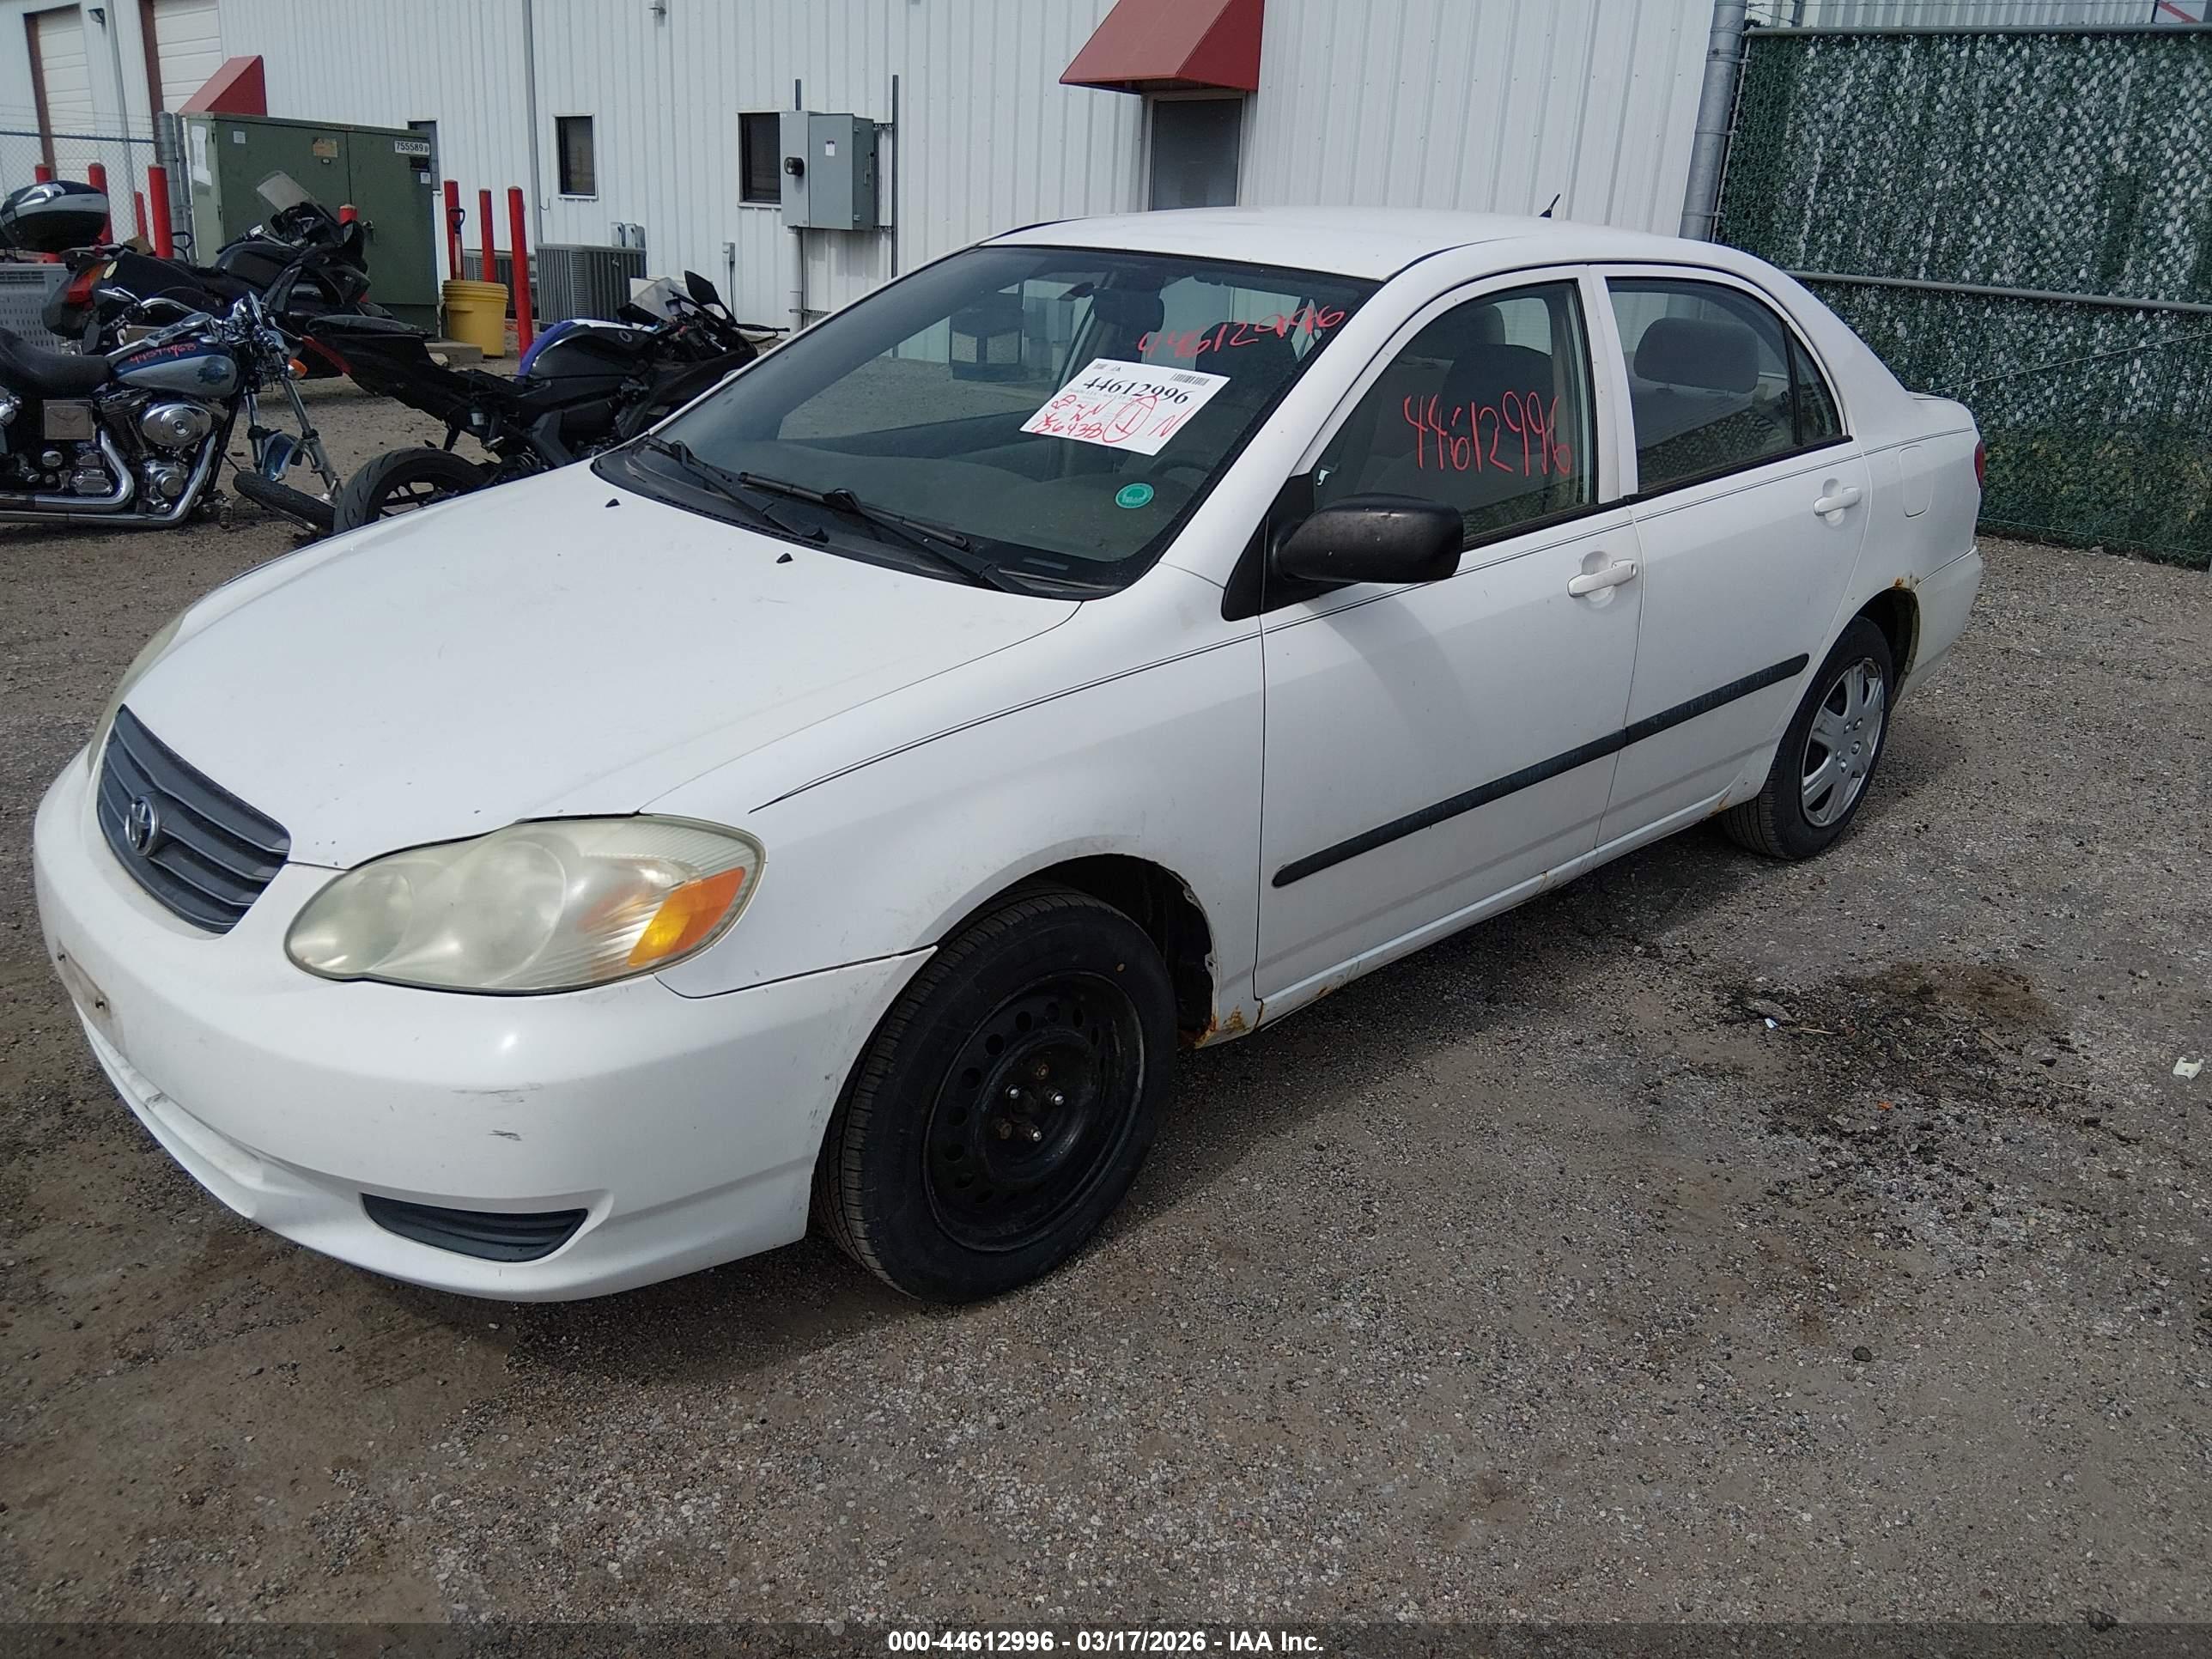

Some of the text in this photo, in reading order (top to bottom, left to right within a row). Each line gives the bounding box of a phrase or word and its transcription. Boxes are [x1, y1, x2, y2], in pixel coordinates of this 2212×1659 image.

[1137, 305, 1345, 358] 44612996
[1083, 376, 1195, 404] 44612996
[1403, 392, 1571, 477] 44612996
